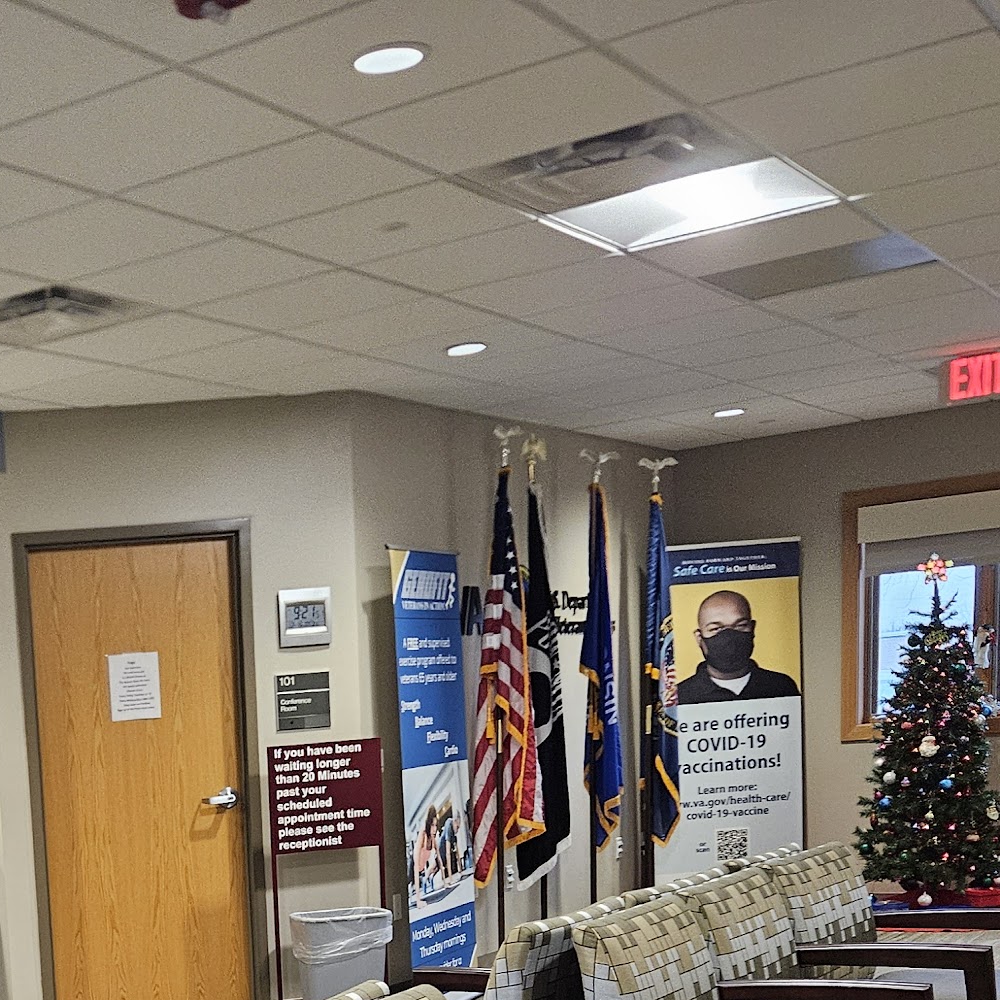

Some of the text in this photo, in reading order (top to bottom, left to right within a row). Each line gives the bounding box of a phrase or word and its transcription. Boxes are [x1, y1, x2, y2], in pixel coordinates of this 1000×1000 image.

[673, 565, 698, 577] Safe
[700, 564, 725, 575] Care
[734, 565, 747, 573] Our
[748, 562, 777, 571] Mission
[279, 676, 296, 686] 101
[280, 698, 312, 706] Conference
[693, 719, 719, 732] are
[724, 712, 790, 729] offering
[687, 734, 766, 753] COVID-19
[274, 744, 362, 760] If you have been
[274, 758, 351, 772] waiting longer
[275, 769, 361, 784] than 20 Minutes
[276, 786, 327, 800] past your
[697, 784, 758, 795] Learn more:
[277, 797, 333, 811] scheduled
[278, 808, 371, 826] appointment time
[686, 807, 770, 820] covid-19-vaccine
[278, 821, 354, 839] please see the
[279, 835, 343, 850] receptionist
[412, 910, 472, 942] Monday, Wednesday and
[420, 933, 466, 958] Thursday mornings
